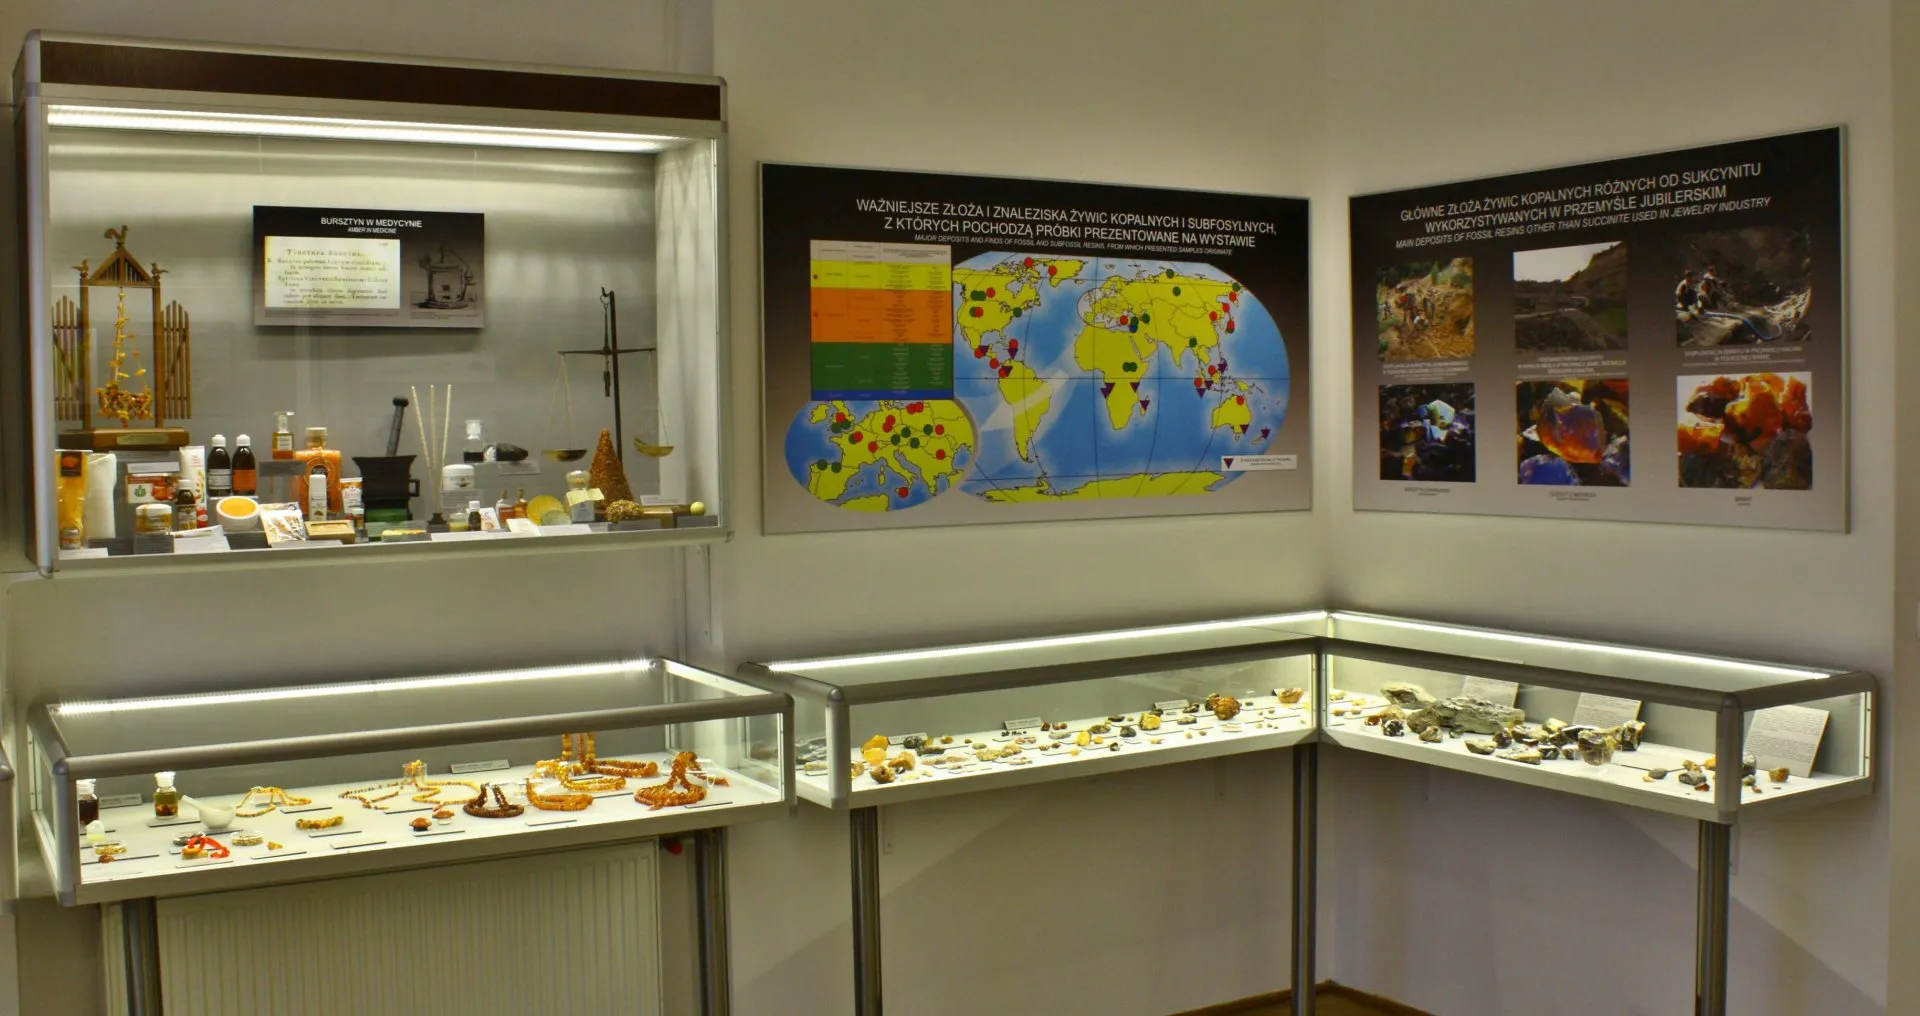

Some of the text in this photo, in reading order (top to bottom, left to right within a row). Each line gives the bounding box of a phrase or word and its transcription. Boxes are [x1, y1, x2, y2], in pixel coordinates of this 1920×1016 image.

[1400, 162, 1762, 221] GŁÓWNE ZŁOŻA ŻYWIC KOPALNYCH RÓŻNYCH OD SUKCYNITU
[1425, 185, 1727, 234] WYKORZYSTYWANYCH W PRZEMYŚLE JUBILERSKIM
[320, 217, 423, 228] BURSZTYN W MEDYCYNIE
[856, 198, 939, 215] WAŻNIEJSZE
[943, 203, 984, 217] ZŁOŻA
[993, 206, 1068, 221] ZNALEZISKA
[1070, 208, 1108, 224] ŻYWIC
[1110, 213, 1179, 228] KOPALNYCH
[1188, 217, 1277, 235] SUBFOSYLNYCH,
[884, 216, 1255, 247] Z KTÓRYCH POCHODZĄ PRÓBKI PREZENTOWANE NA WYSTAWIE
[1395, 196, 1772, 249] MAIN DEPOSITS OF FOSSIL RESINS OTHER THAN SUCCINITE USED IN JEWELRY INDUSTRY
[938, 235, 969, 243] DEPOSITS
[984, 237, 1003, 245] FINDS
[1014, 238, 1035, 246] FOSSIL
[1036, 239, 1049, 247] AND
